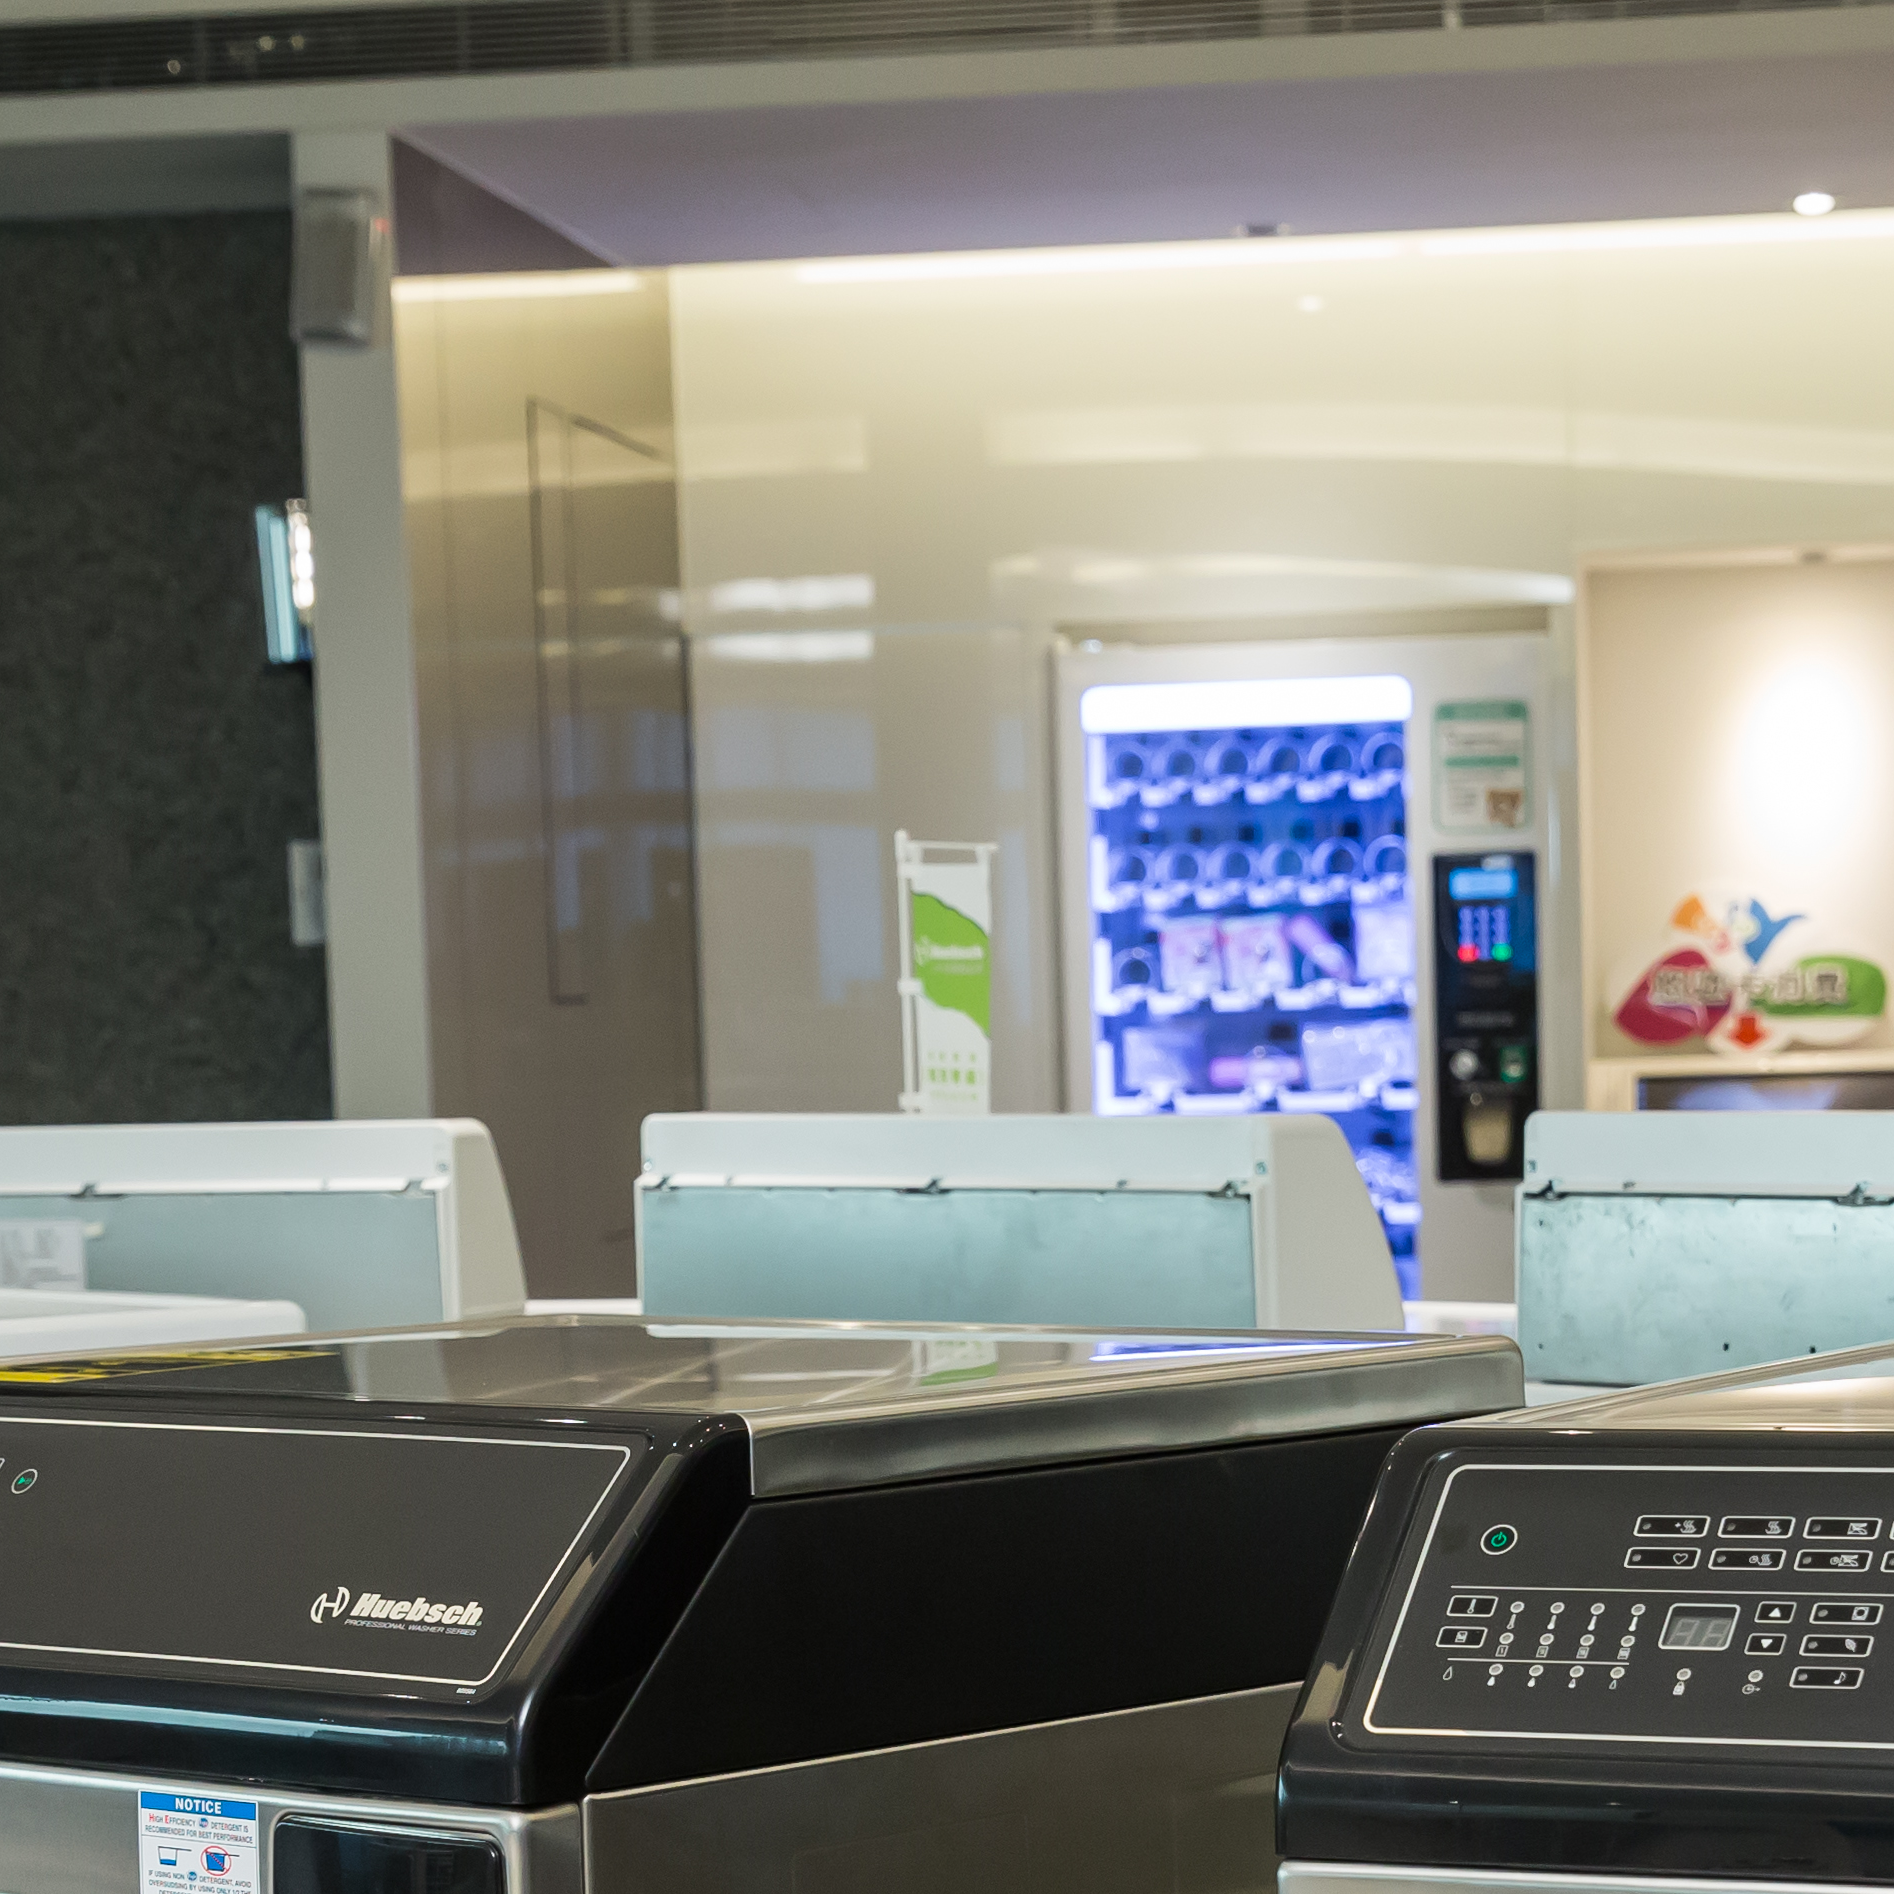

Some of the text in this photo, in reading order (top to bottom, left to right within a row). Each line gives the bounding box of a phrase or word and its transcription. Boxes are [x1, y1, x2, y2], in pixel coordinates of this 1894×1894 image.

[350, 1592, 484, 1627] Huebsch
[344, 1618, 477, 1636] PROFESSIONAL WASHER SERIES
[175, 1797, 222, 1815] NOTICE
[145, 1825, 253, 1844] RECOMMENDED FOR BEST PERFORMANCE
[210, 1822, 243, 1832] DETERGENT
[243, 1825, 249, 1833] IS
[154, 1870, 171, 1879] USING
[172, 1872, 185, 1880] NON
[235, 1880, 252, 1888] AVOID
[197, 1884, 215, 1893] USING
[216, 1886, 231, 1894] ONLY
